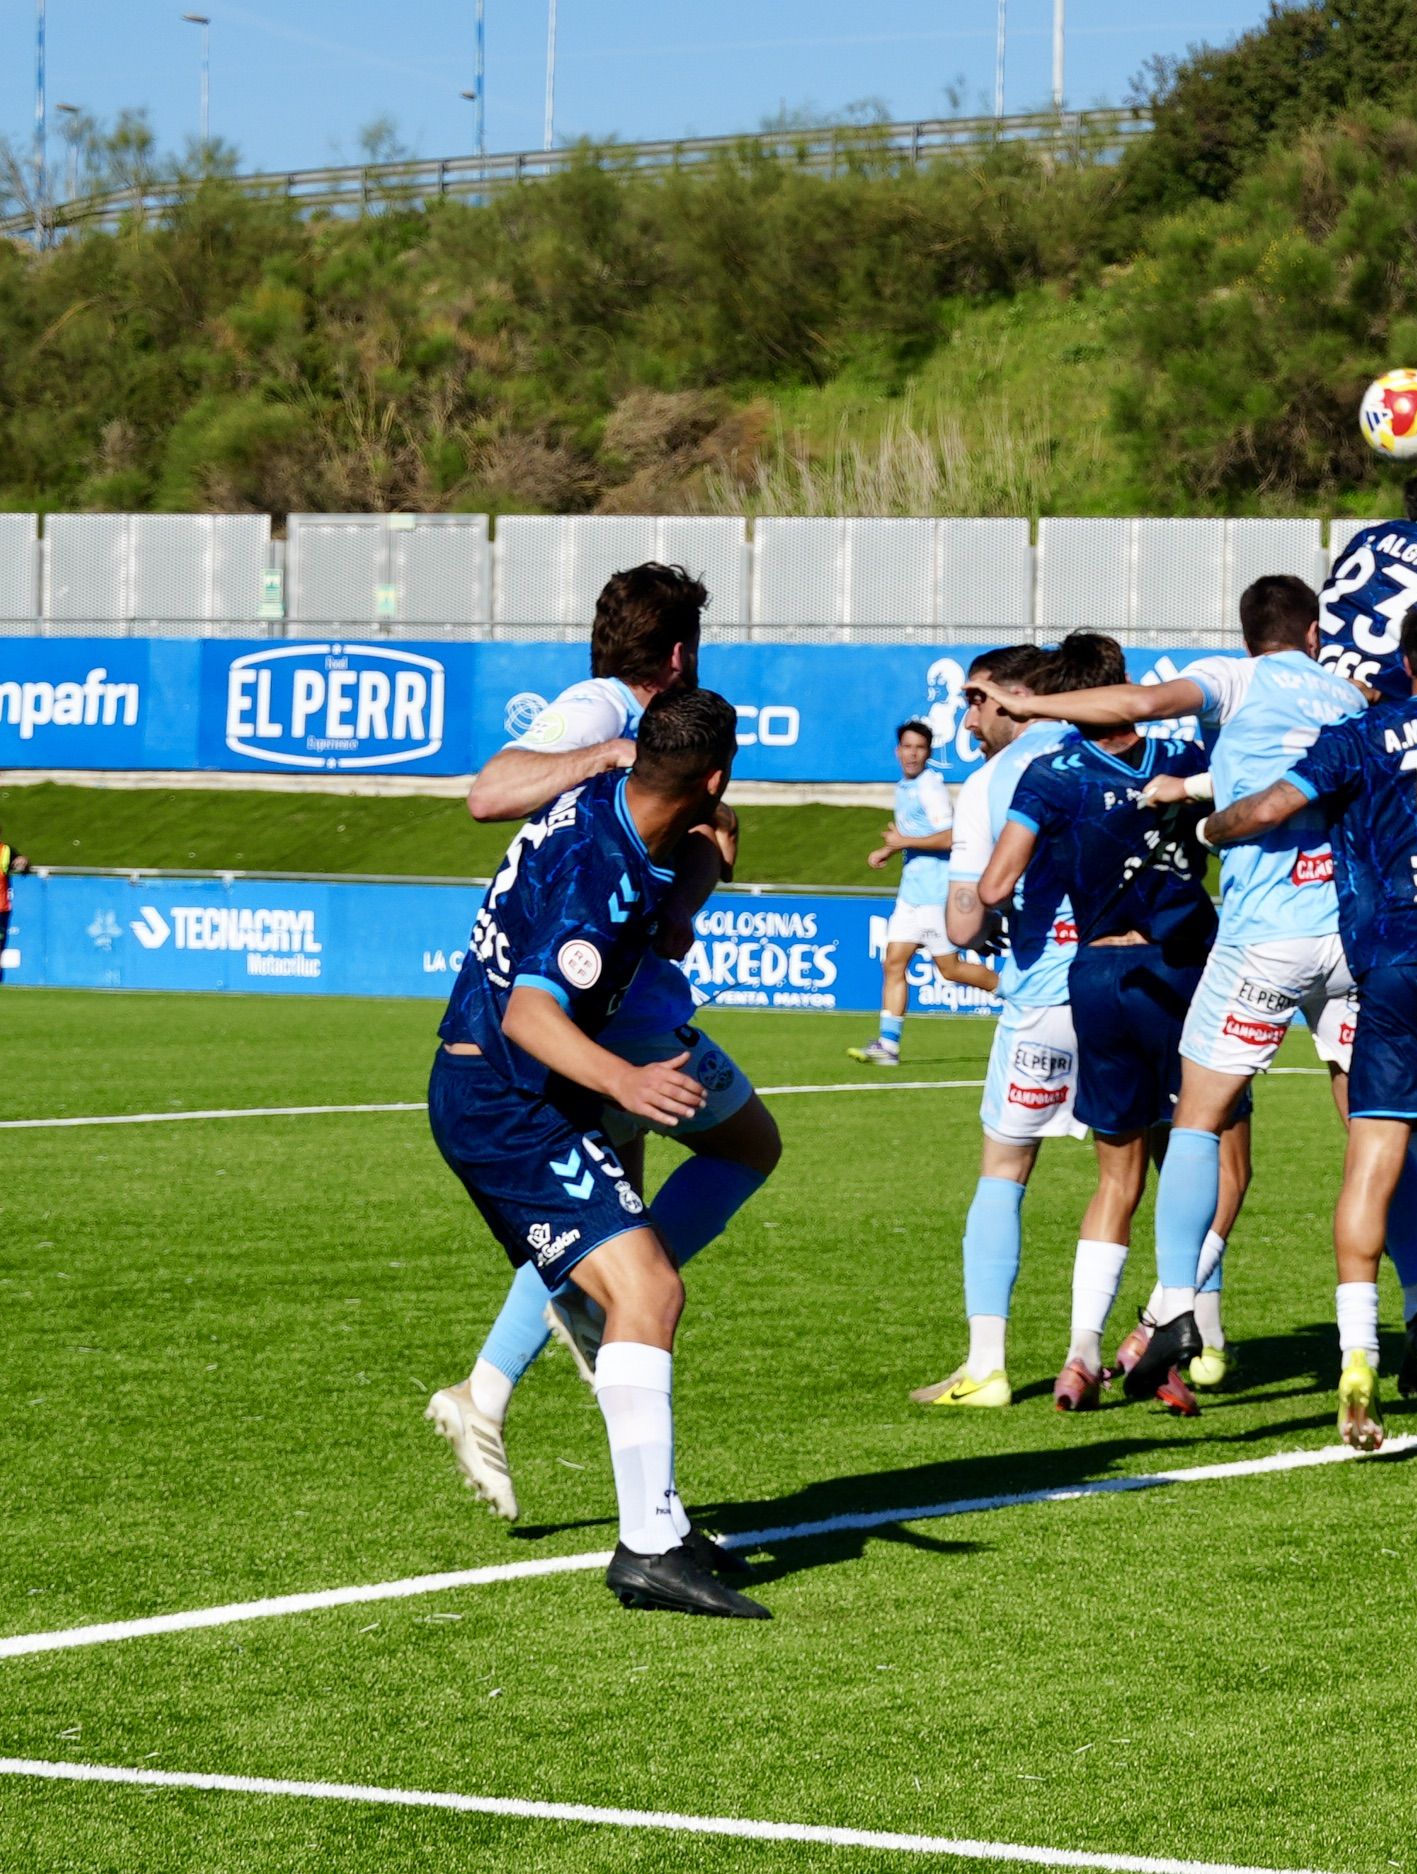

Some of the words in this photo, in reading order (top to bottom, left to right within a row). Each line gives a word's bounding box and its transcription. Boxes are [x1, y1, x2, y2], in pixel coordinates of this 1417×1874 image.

[226, 668, 283, 738] EL
[170, 906, 322, 952] TECNACRYL
[694, 910, 818, 939] GOLOSINAS
[423, 949, 447, 972] LA
[681, 939, 838, 988] AREDES
